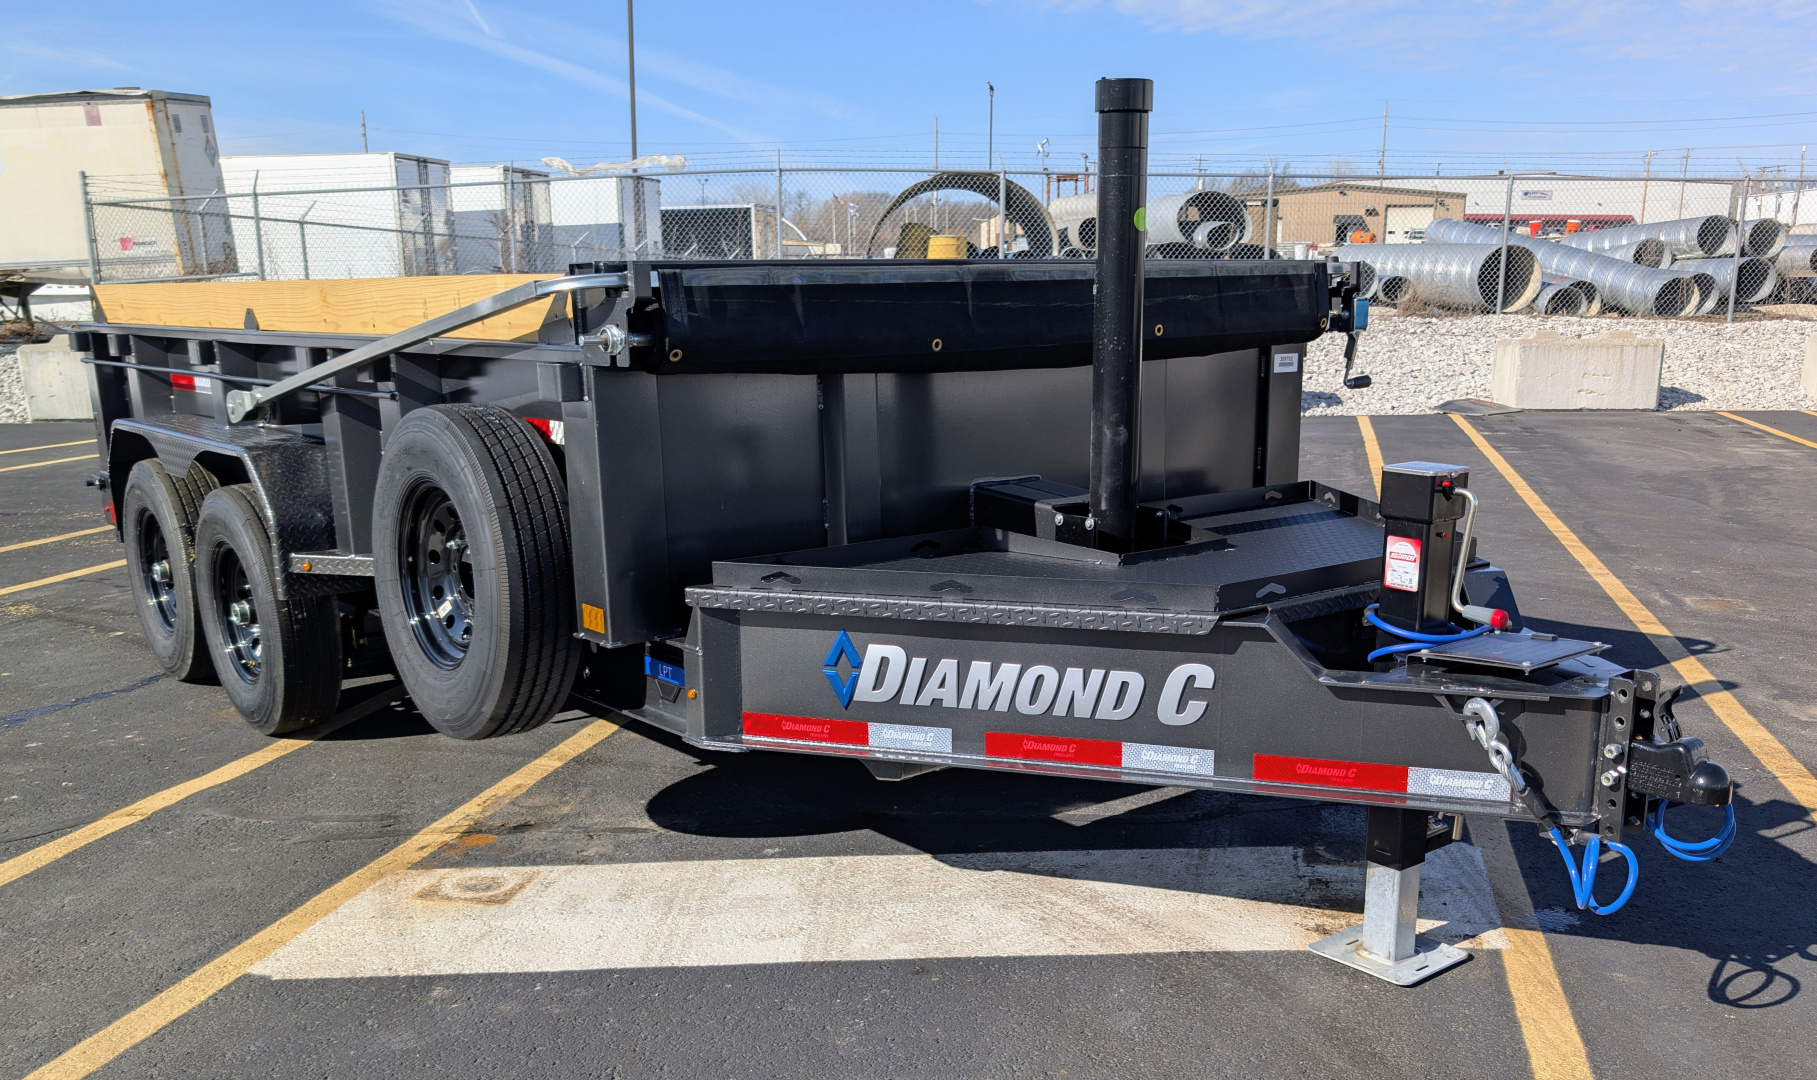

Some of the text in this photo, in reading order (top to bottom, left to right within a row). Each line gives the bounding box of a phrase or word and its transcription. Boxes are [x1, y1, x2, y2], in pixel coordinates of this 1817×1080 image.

[659, 664, 672, 679] LPT
[854, 643, 1216, 726] DIAMOND C
[785, 721, 830, 733] DIAMOND C
[887, 730, 934, 742] DIAMOND C
[1028, 740, 1076, 753] DIAMOND C
[1147, 750, 1198, 764] DIAMOND C
[1300, 764, 1356, 778] DIAMOND C
[1435, 775, 1494, 788] DIAMOND C
